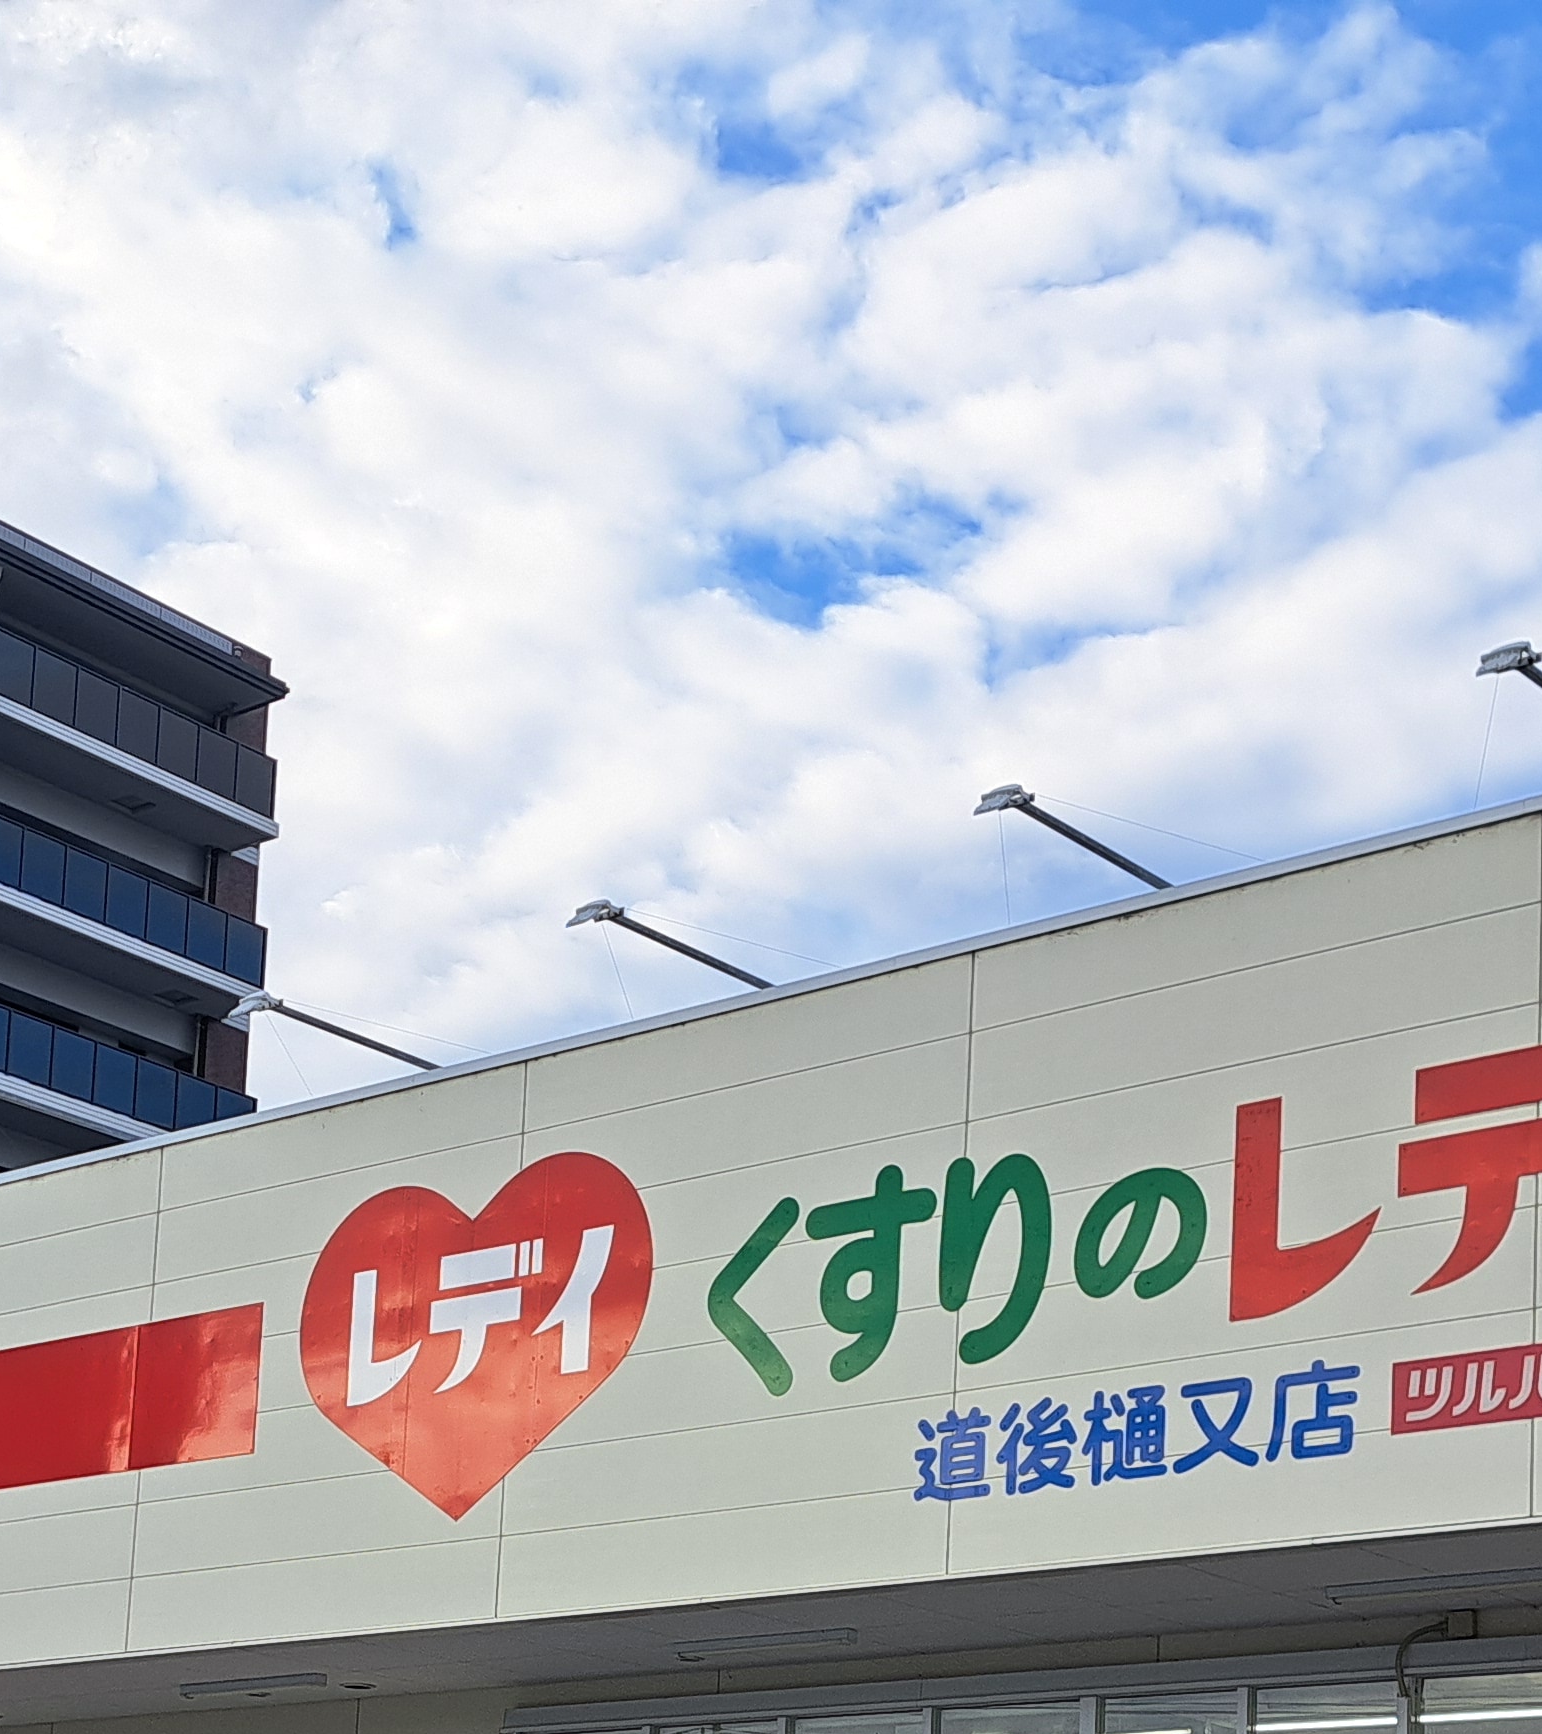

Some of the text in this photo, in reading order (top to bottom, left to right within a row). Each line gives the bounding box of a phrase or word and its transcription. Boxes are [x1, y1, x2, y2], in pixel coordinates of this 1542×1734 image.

[913, 1358, 1362, 1504] 道後樋又店
